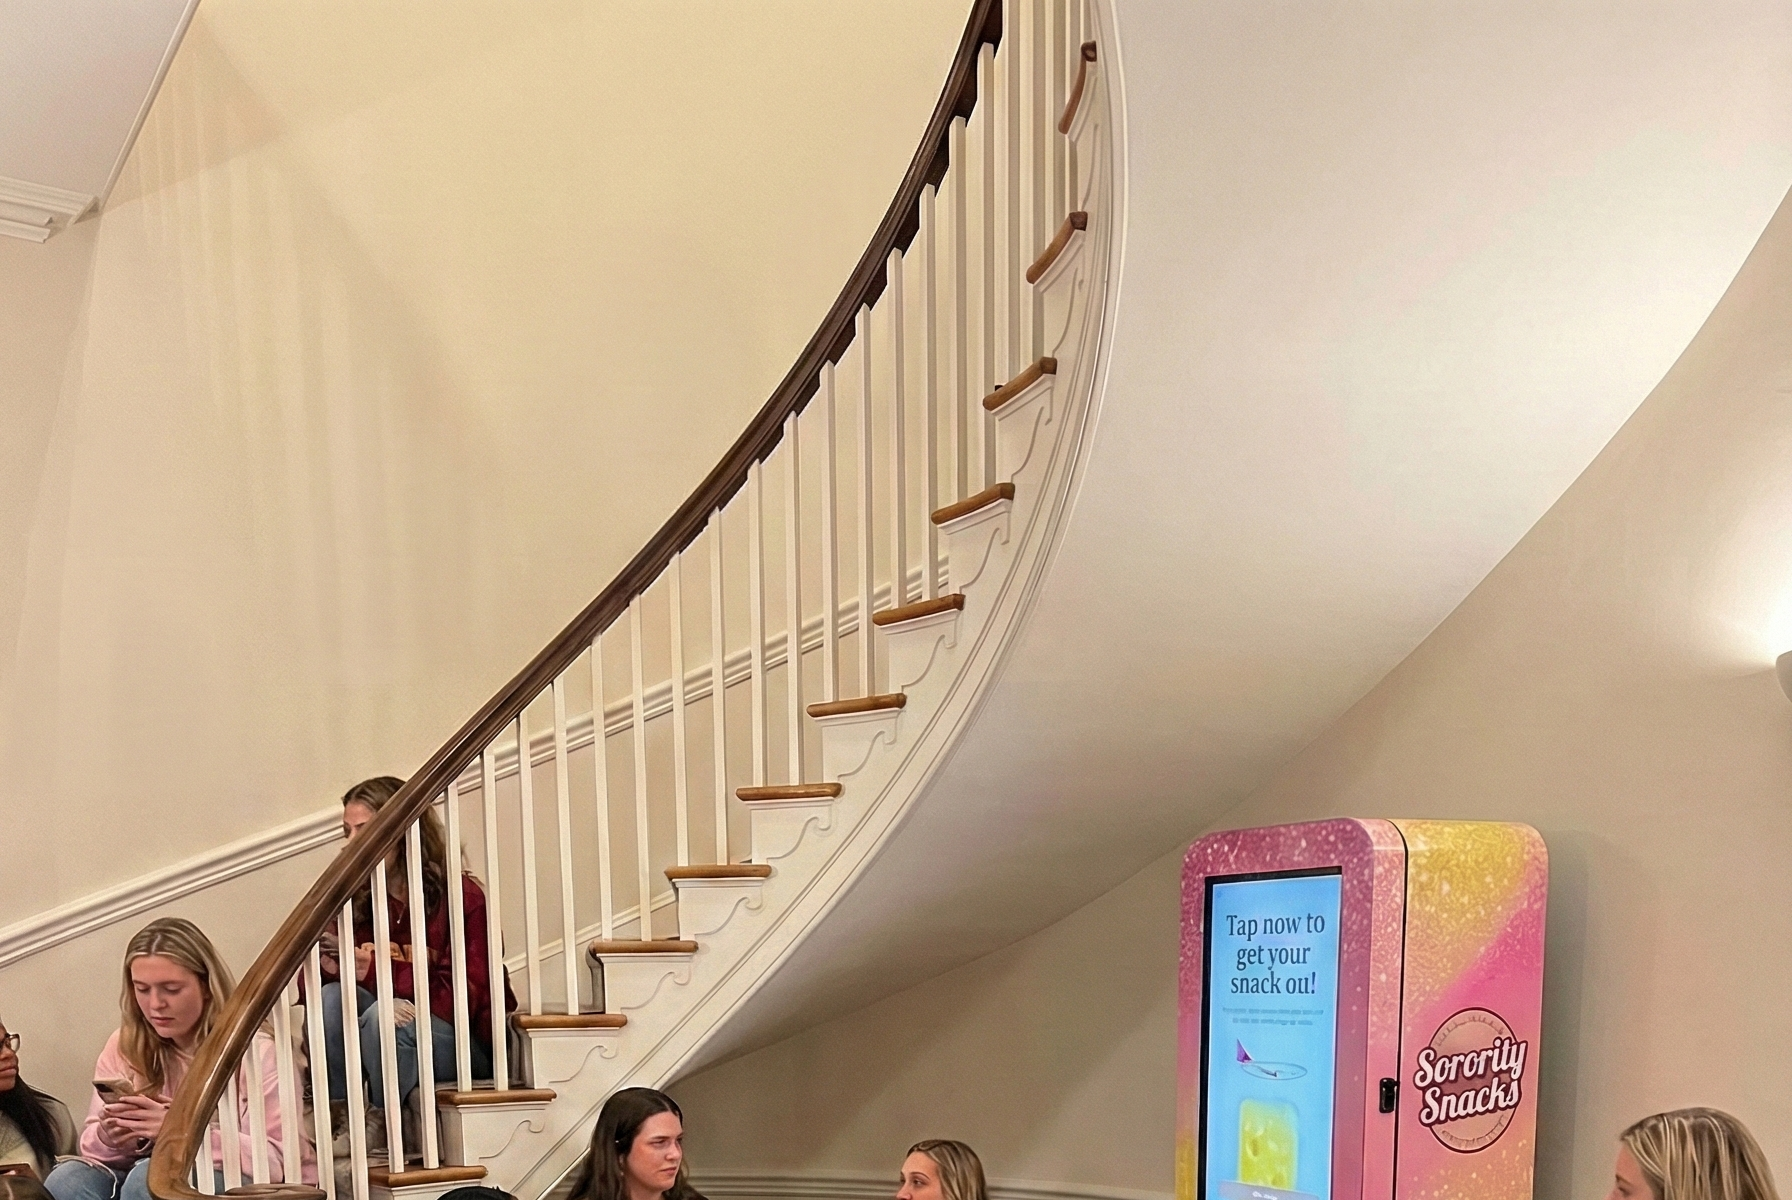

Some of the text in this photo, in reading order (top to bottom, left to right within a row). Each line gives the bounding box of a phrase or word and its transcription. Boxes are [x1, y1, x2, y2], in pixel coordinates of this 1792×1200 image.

[1226, 912, 1326, 942] Tap now to
[1236, 945, 1311, 971] get your
[1230, 970, 1282, 994] snack
[1414, 1038, 1527, 1088] Sorority
[1420, 1076, 1520, 1124] Snacks
